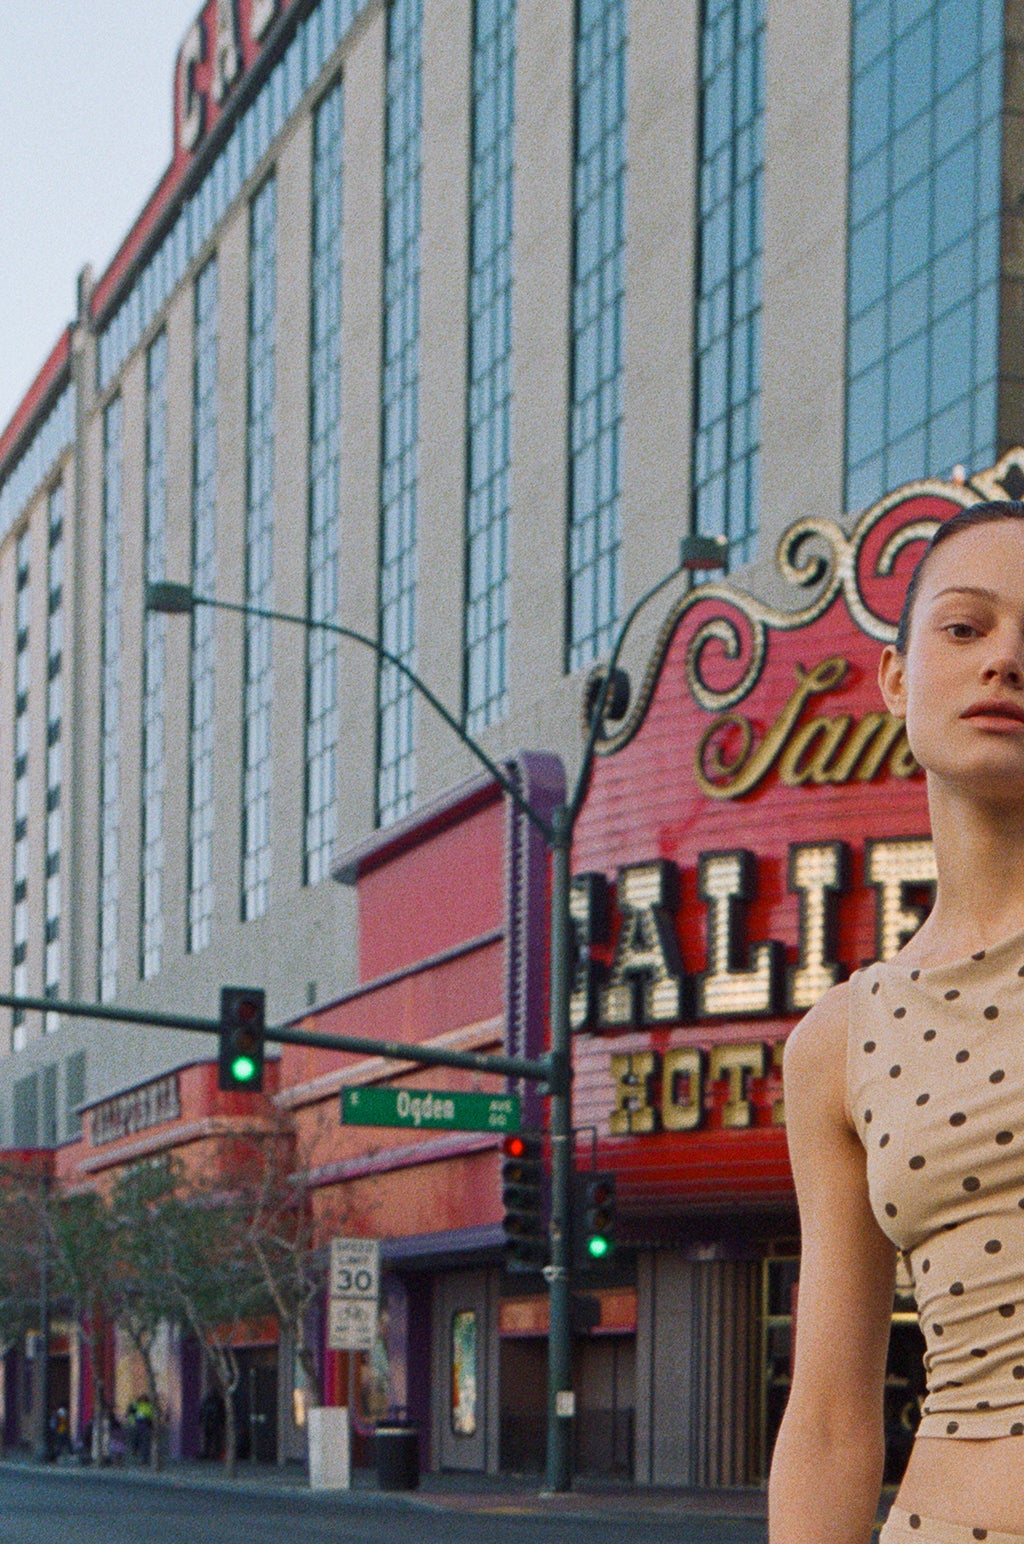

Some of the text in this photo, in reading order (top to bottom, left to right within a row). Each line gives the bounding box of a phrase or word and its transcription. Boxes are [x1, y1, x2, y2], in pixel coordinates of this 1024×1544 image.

[609, 1041, 785, 1136] HOT
[396, 1090, 455, 1127] Ogden
[337, 1268, 372, 1291] 30
